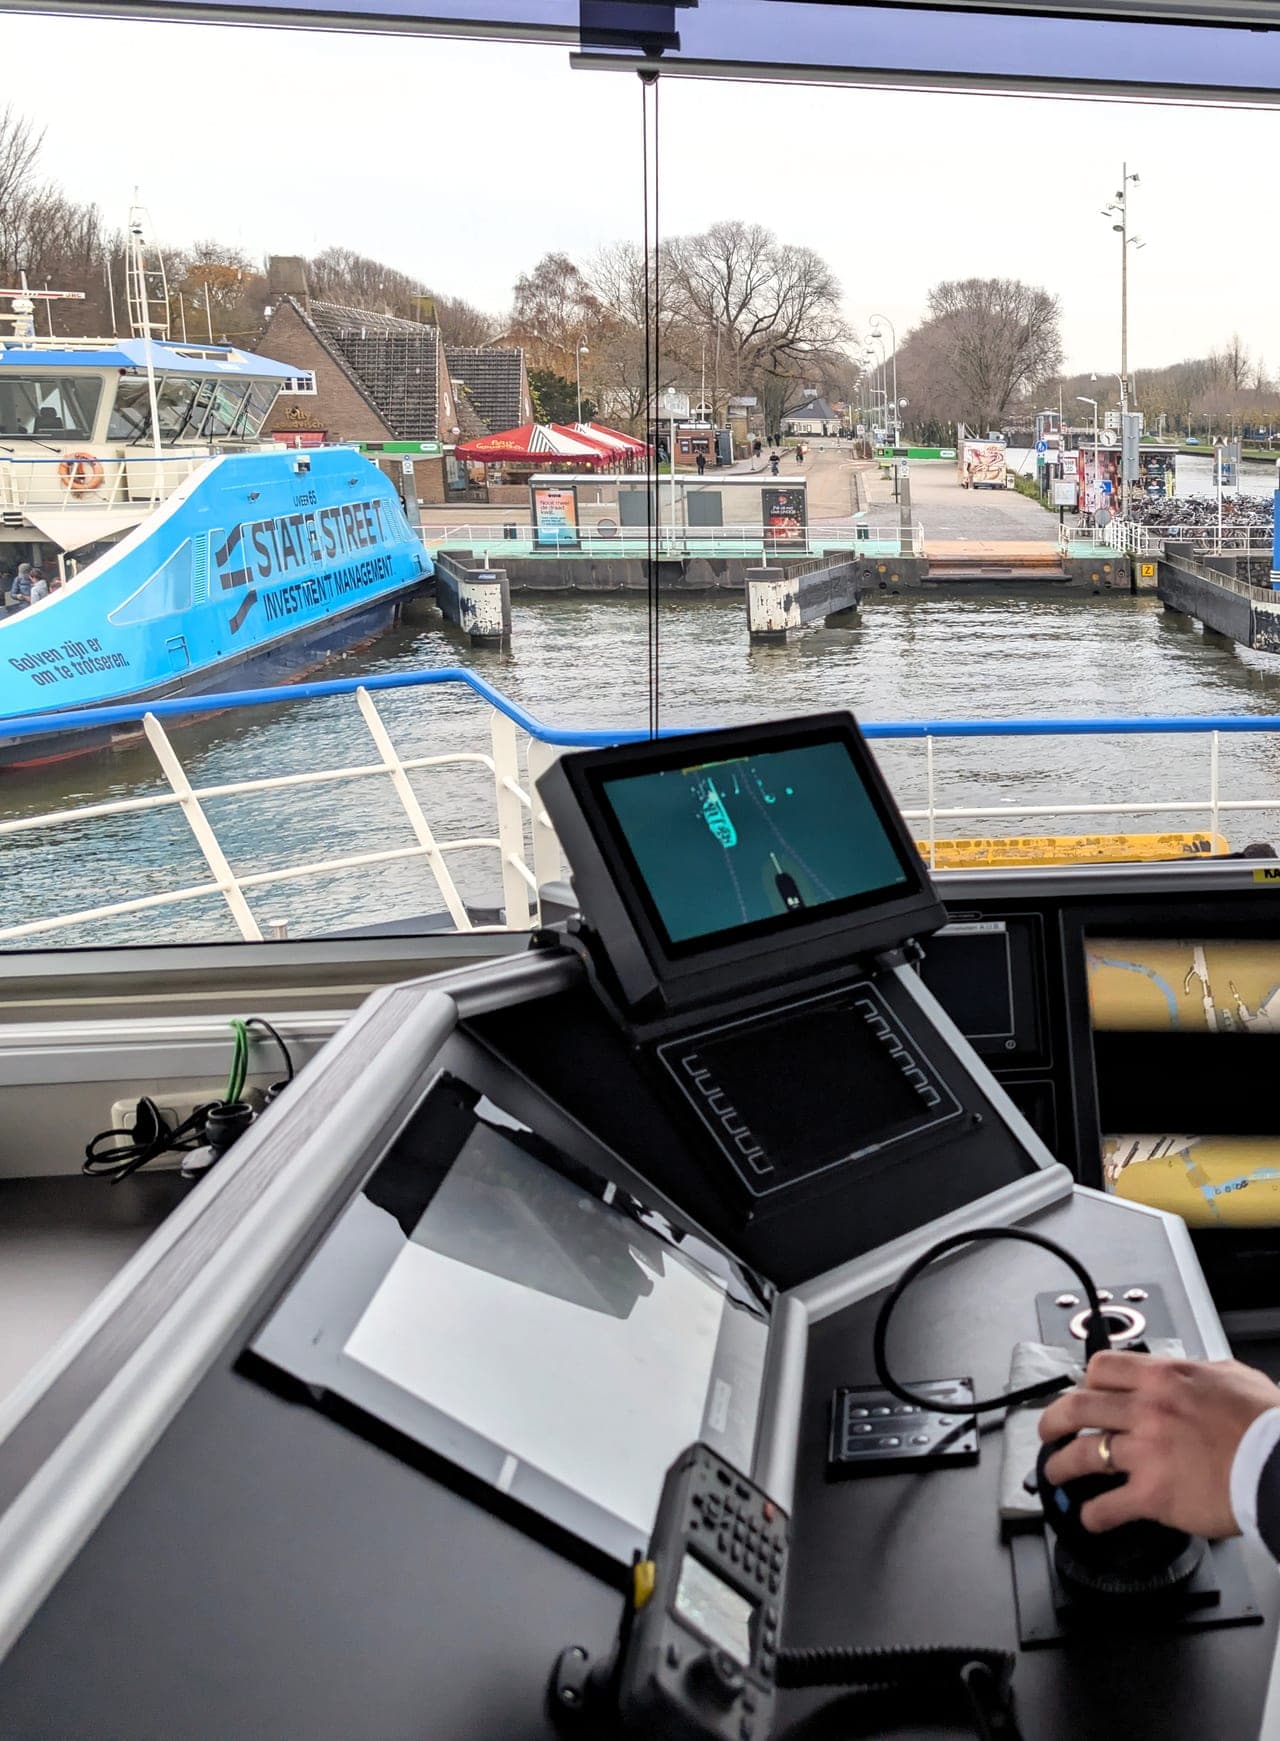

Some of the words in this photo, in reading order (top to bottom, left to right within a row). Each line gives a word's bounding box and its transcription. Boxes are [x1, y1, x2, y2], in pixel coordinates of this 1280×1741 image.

[309, 491, 317, 505] 65
[252, 514, 322, 578] STATE
[320, 500, 384, 558] STREET
[1145, 566, 1151, 575] Z
[262, 570, 334, 623] INVESTMENT
[333, 555, 392, 595] MANAGEMENT
[8, 648, 65, 672] Golven
[60, 640, 89, 660] zijn
[87, 637, 103, 652] er
[31, 669, 59, 686] om
[54, 664, 75, 680] te
[70, 652, 131, 676] trotseren.
